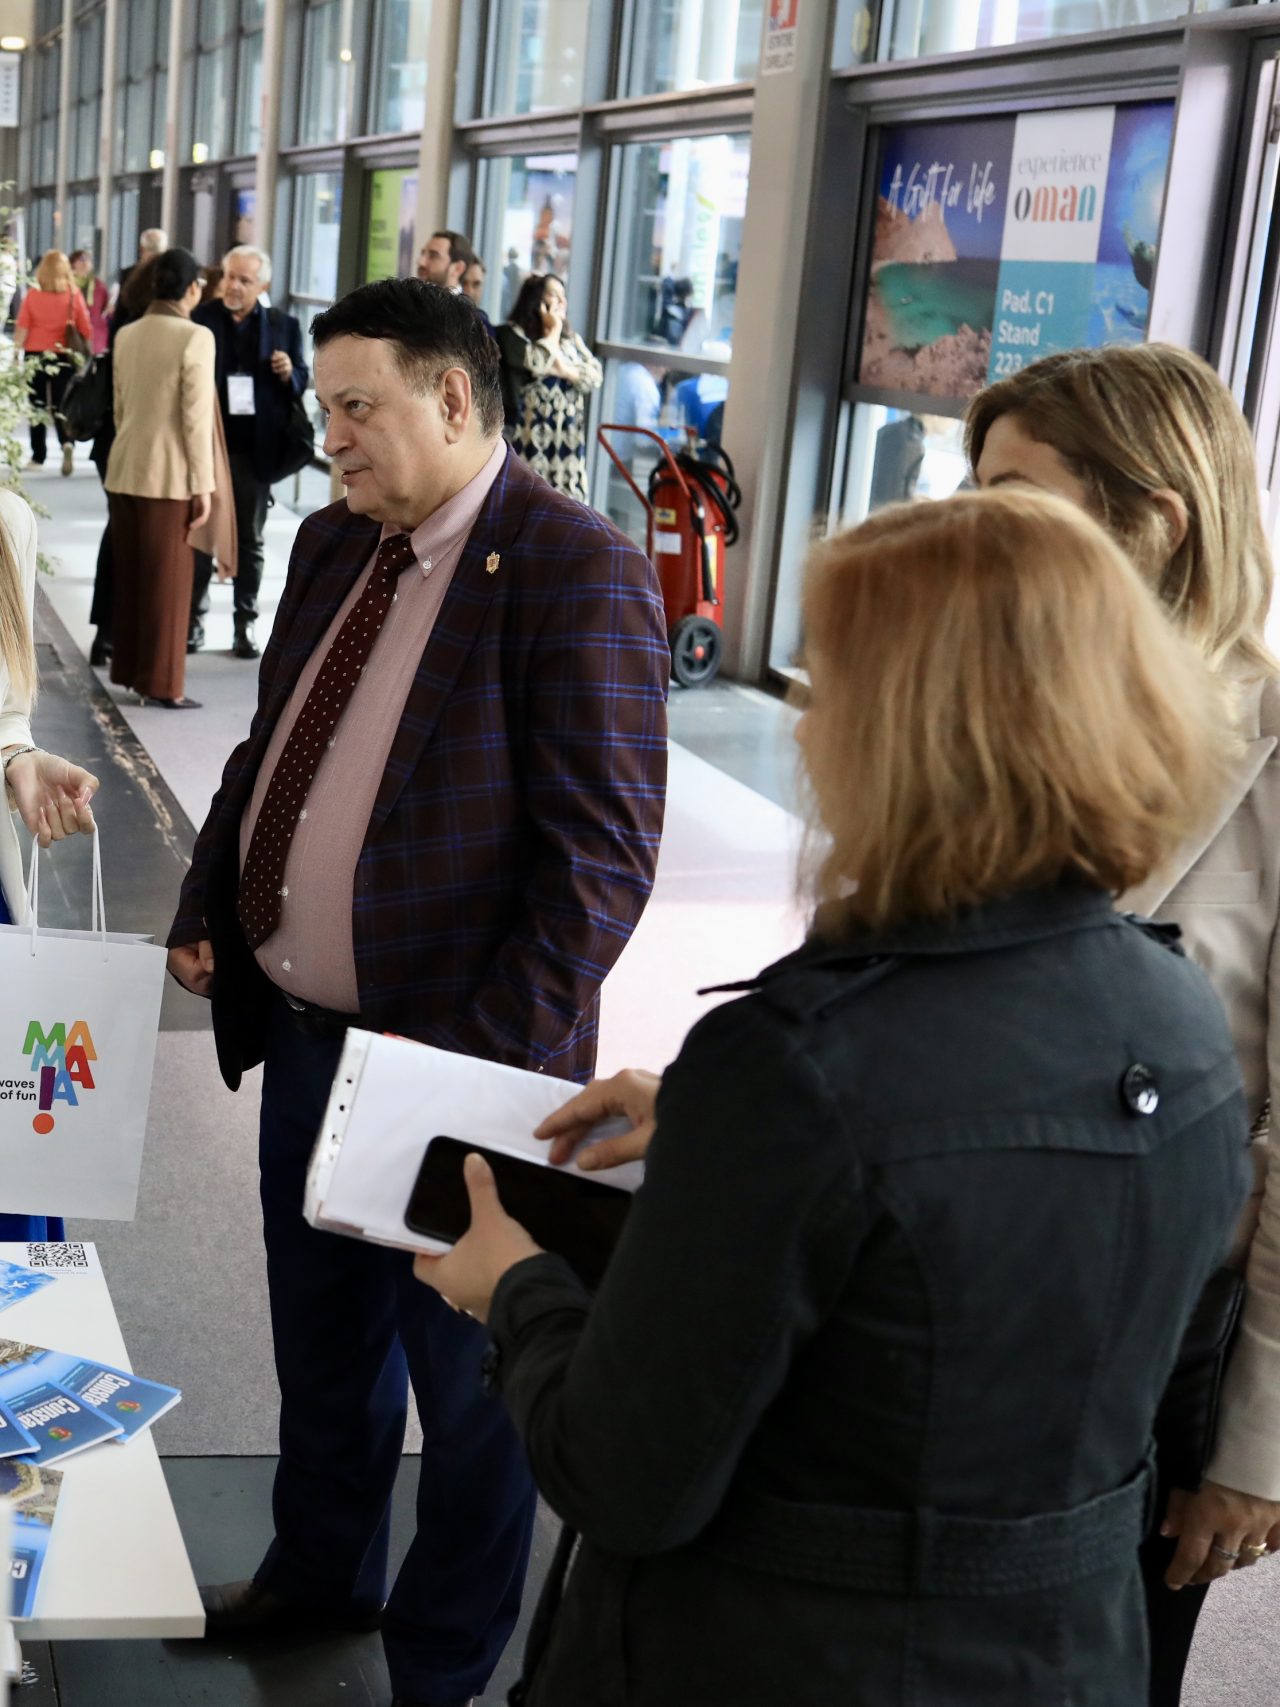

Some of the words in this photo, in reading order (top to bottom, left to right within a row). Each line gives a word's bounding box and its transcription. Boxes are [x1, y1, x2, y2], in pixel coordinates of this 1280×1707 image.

[1018, 151, 1102, 181] experience
[1014, 184, 1097, 223] oman
[1001, 289, 1032, 314] Pad.
[1035, 291, 1055, 315] C1
[998, 320, 1041, 346] Stand
[0, 1090, 13, 1101] of
[16, 1090, 37, 1101] fun
